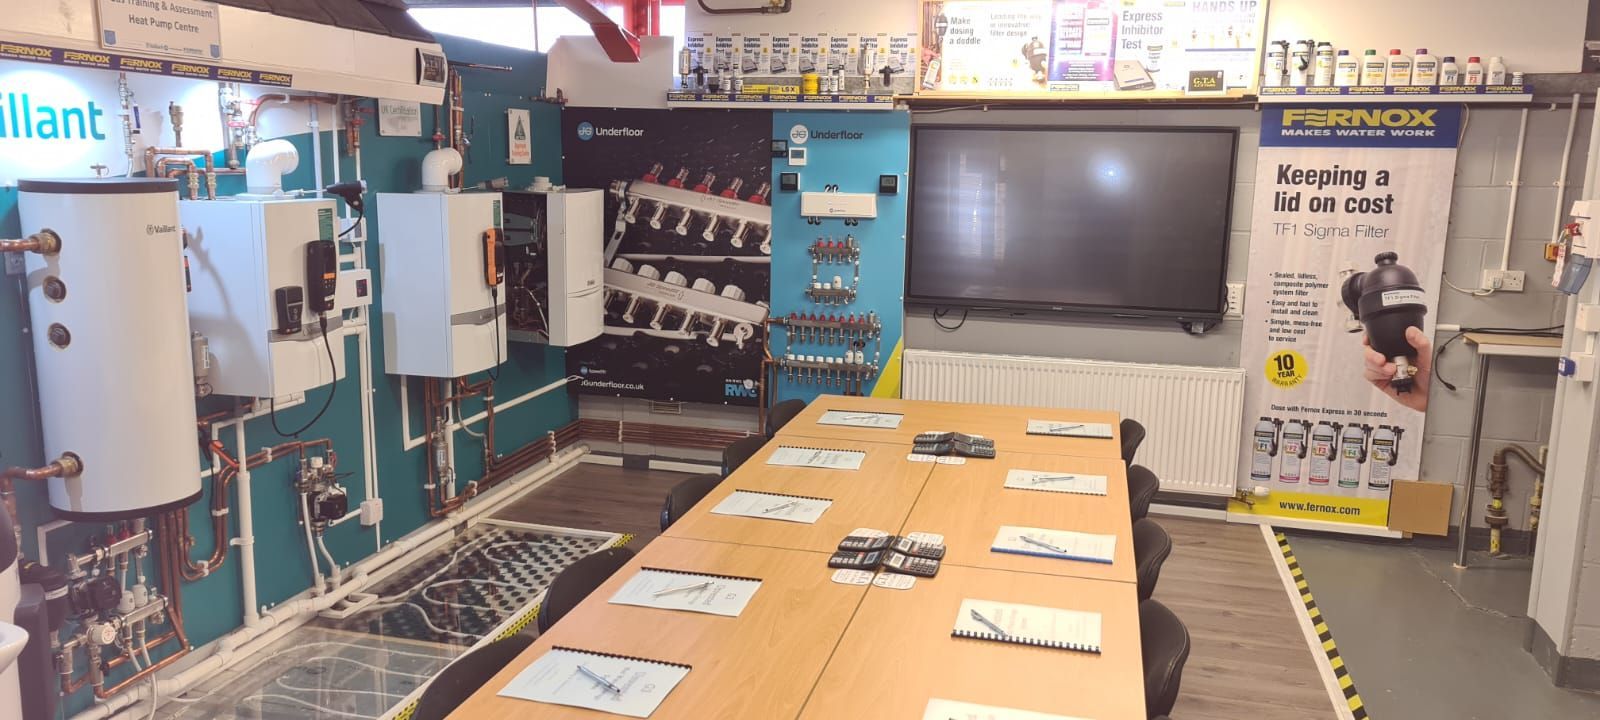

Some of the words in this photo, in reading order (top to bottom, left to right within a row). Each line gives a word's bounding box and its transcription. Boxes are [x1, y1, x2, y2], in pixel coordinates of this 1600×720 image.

[128, 0, 160, 11] Training
[161, 2, 168, 11] &
[169, 2, 213, 18] Assessment
[950, 16, 971, 25] Make
[1122, 10, 1163, 22] Express
[128, 14, 149, 26] Heat
[150, 17, 173, 30] Pump
[174, 21, 200, 33] Centre
[950, 26, 974, 36] dosing
[1121, 24, 1164, 35] Inhibitor
[956, 36, 982, 45] doddle
[1122, 38, 1142, 49] Test
[1, 44, 52, 57] FERNOX
[64, 51, 110, 63] FERNOX
[121, 58, 162, 69] FERNOX
[172, 63, 209, 74] FERNOX
[218, 68, 252, 79] FERNOX
[260, 73, 291, 83] FERNOX
[1281, 108, 1439, 127] FERNOX
[595, 127, 644, 137] Underfloor
[810, 130, 865, 140] Underfloor
[1281, 129, 1331, 137] MAKES
[1336, 129, 1386, 137] WATER
[1276, 164, 1368, 190] Keeping
[1375, 169, 1390, 187] a
[1273, 191, 1302, 212] lid
[1308, 196, 1336, 213] on
[1344, 194, 1395, 214] cost
[153, 224, 176, 233] Vaillant
[1272, 222, 1297, 236] TF1
[1303, 223, 1350, 240] Sigma
[1355, 224, 1390, 238] Filter
[1273, 280, 1304, 288] composite
[1305, 281, 1329, 289] polymer
[1272, 289, 1294, 297] system
[1295, 289, 1309, 297] filter
[1271, 299, 1286, 308] Easy
[1290, 308, 1301, 316] and
[1302, 308, 1319, 316] clean
[1270, 318, 1292, 328] Simple,
[1293, 320, 1323, 328] mess-free
[1293, 327, 1306, 335] cost
[1275, 335, 1297, 343] service
[1274, 354, 1295, 371] 10
[1277, 370, 1295, 379] YEAR
[1271, 375, 1303, 387] WARRANTY
[1271, 404, 1286, 412] Dose
[1300, 406, 1321, 414] Fernox
[1322, 407, 1345, 416] Express
[1363, 410, 1388, 418] seconds
[1279, 501, 1361, 516] www.fernox.com
